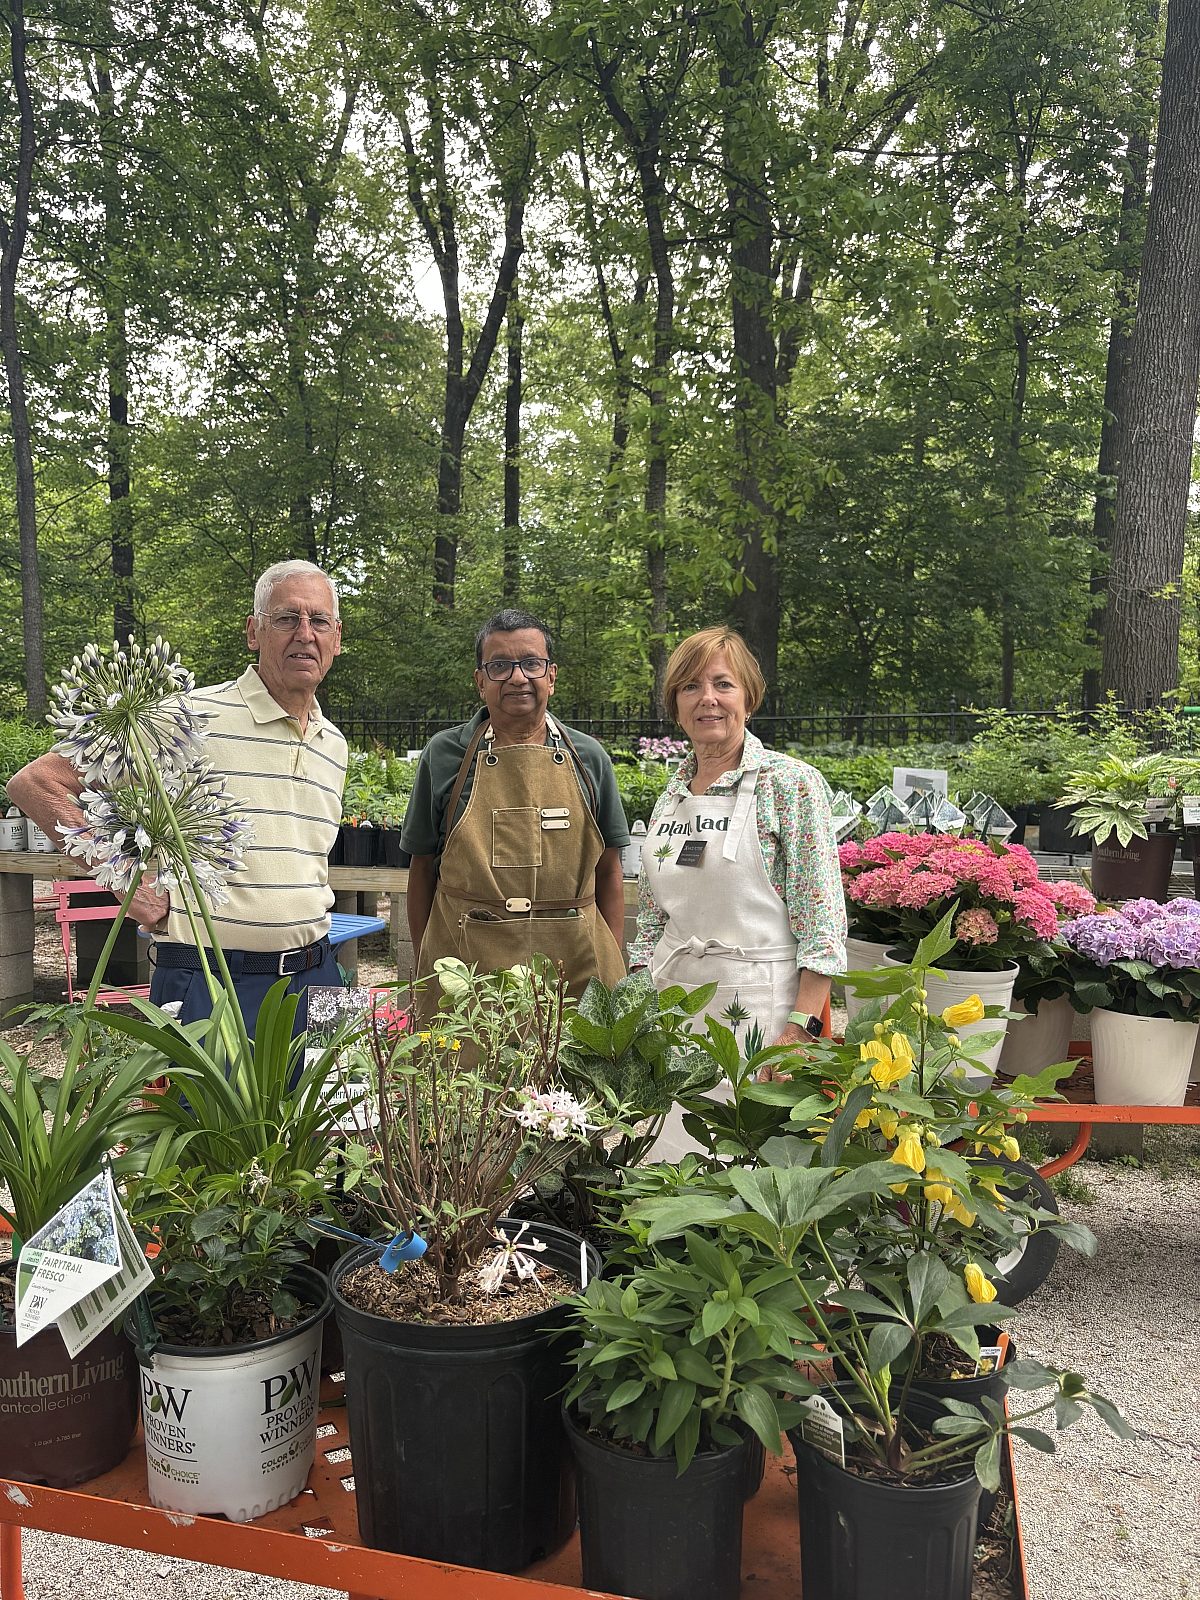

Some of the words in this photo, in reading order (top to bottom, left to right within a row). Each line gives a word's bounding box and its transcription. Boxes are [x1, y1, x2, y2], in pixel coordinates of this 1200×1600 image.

[695, 815, 731, 832] lad
[36, 1268, 65, 1283] FRESCO
[41, 1256, 83, 1274] FAIRYTRAIL
[0, 1371, 70, 1398] outhern
[72, 1352, 128, 1390] Living
[260, 1348, 317, 1416] PW
[1, 1391, 91, 1413] antcollection
[141, 1369, 192, 1423] PW
[260, 1399, 315, 1445] WINNERS
[266, 1391, 313, 1429] PROVEN
[145, 1410, 187, 1439] PROVEN
[261, 1453, 288, 1470] COLOR
[262, 1453, 299, 1475] FLOWERING
